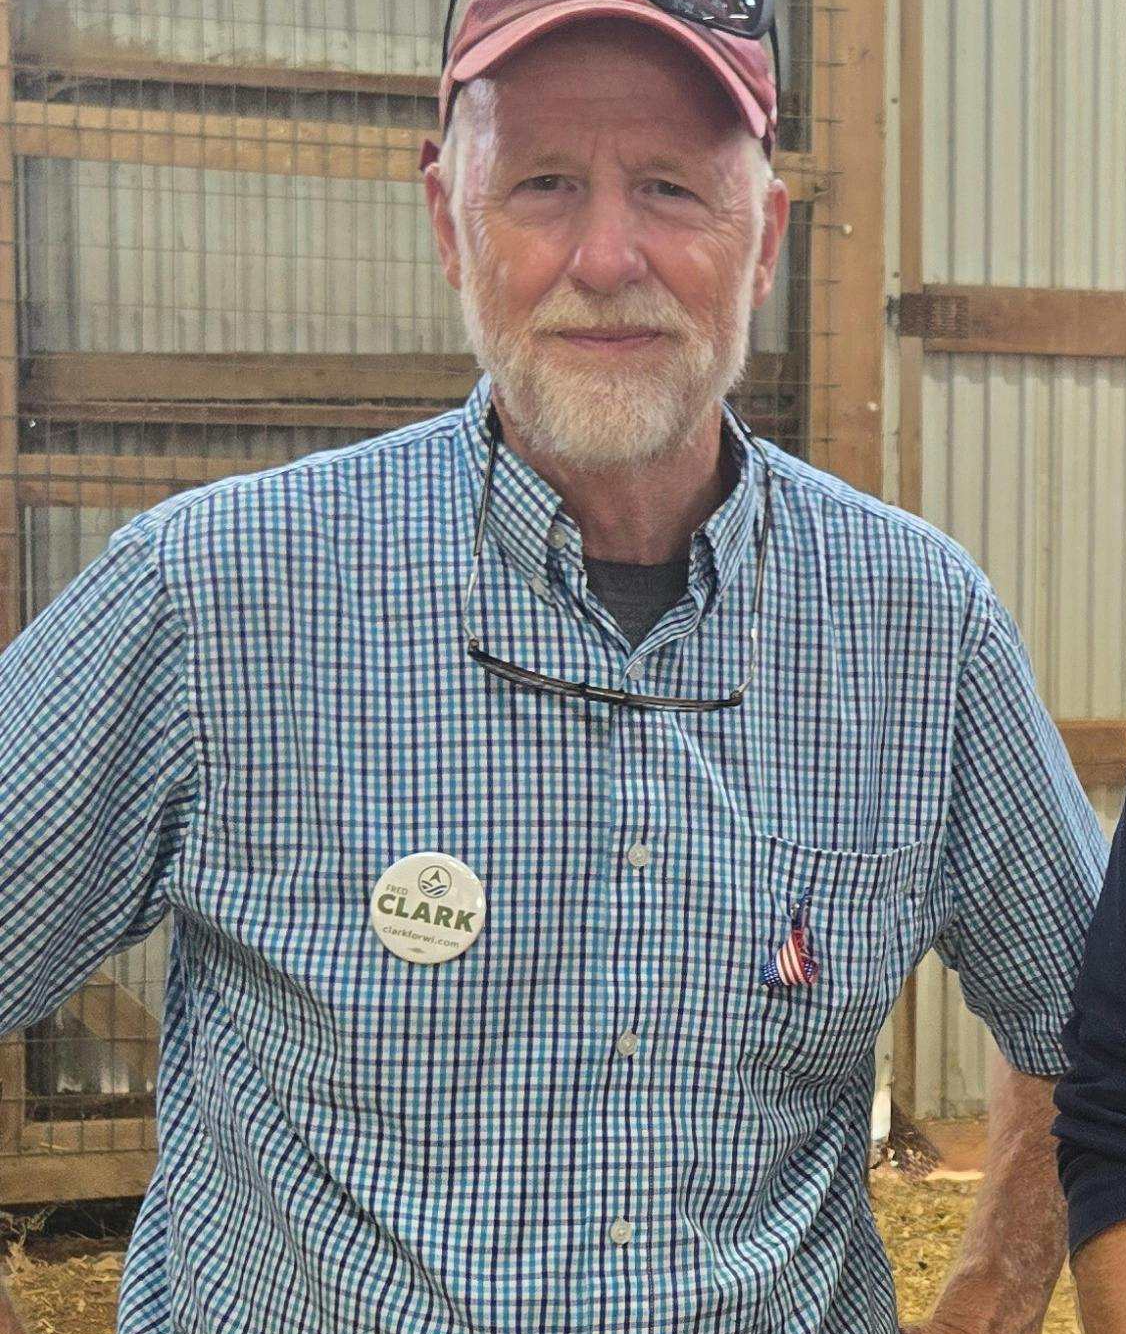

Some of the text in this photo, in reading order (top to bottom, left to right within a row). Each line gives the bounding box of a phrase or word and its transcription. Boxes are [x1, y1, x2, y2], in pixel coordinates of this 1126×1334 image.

[385, 884, 408, 895] FRED
[377, 893, 477, 933] CLARK
[382, 925, 460, 948] clarkforwi.com
